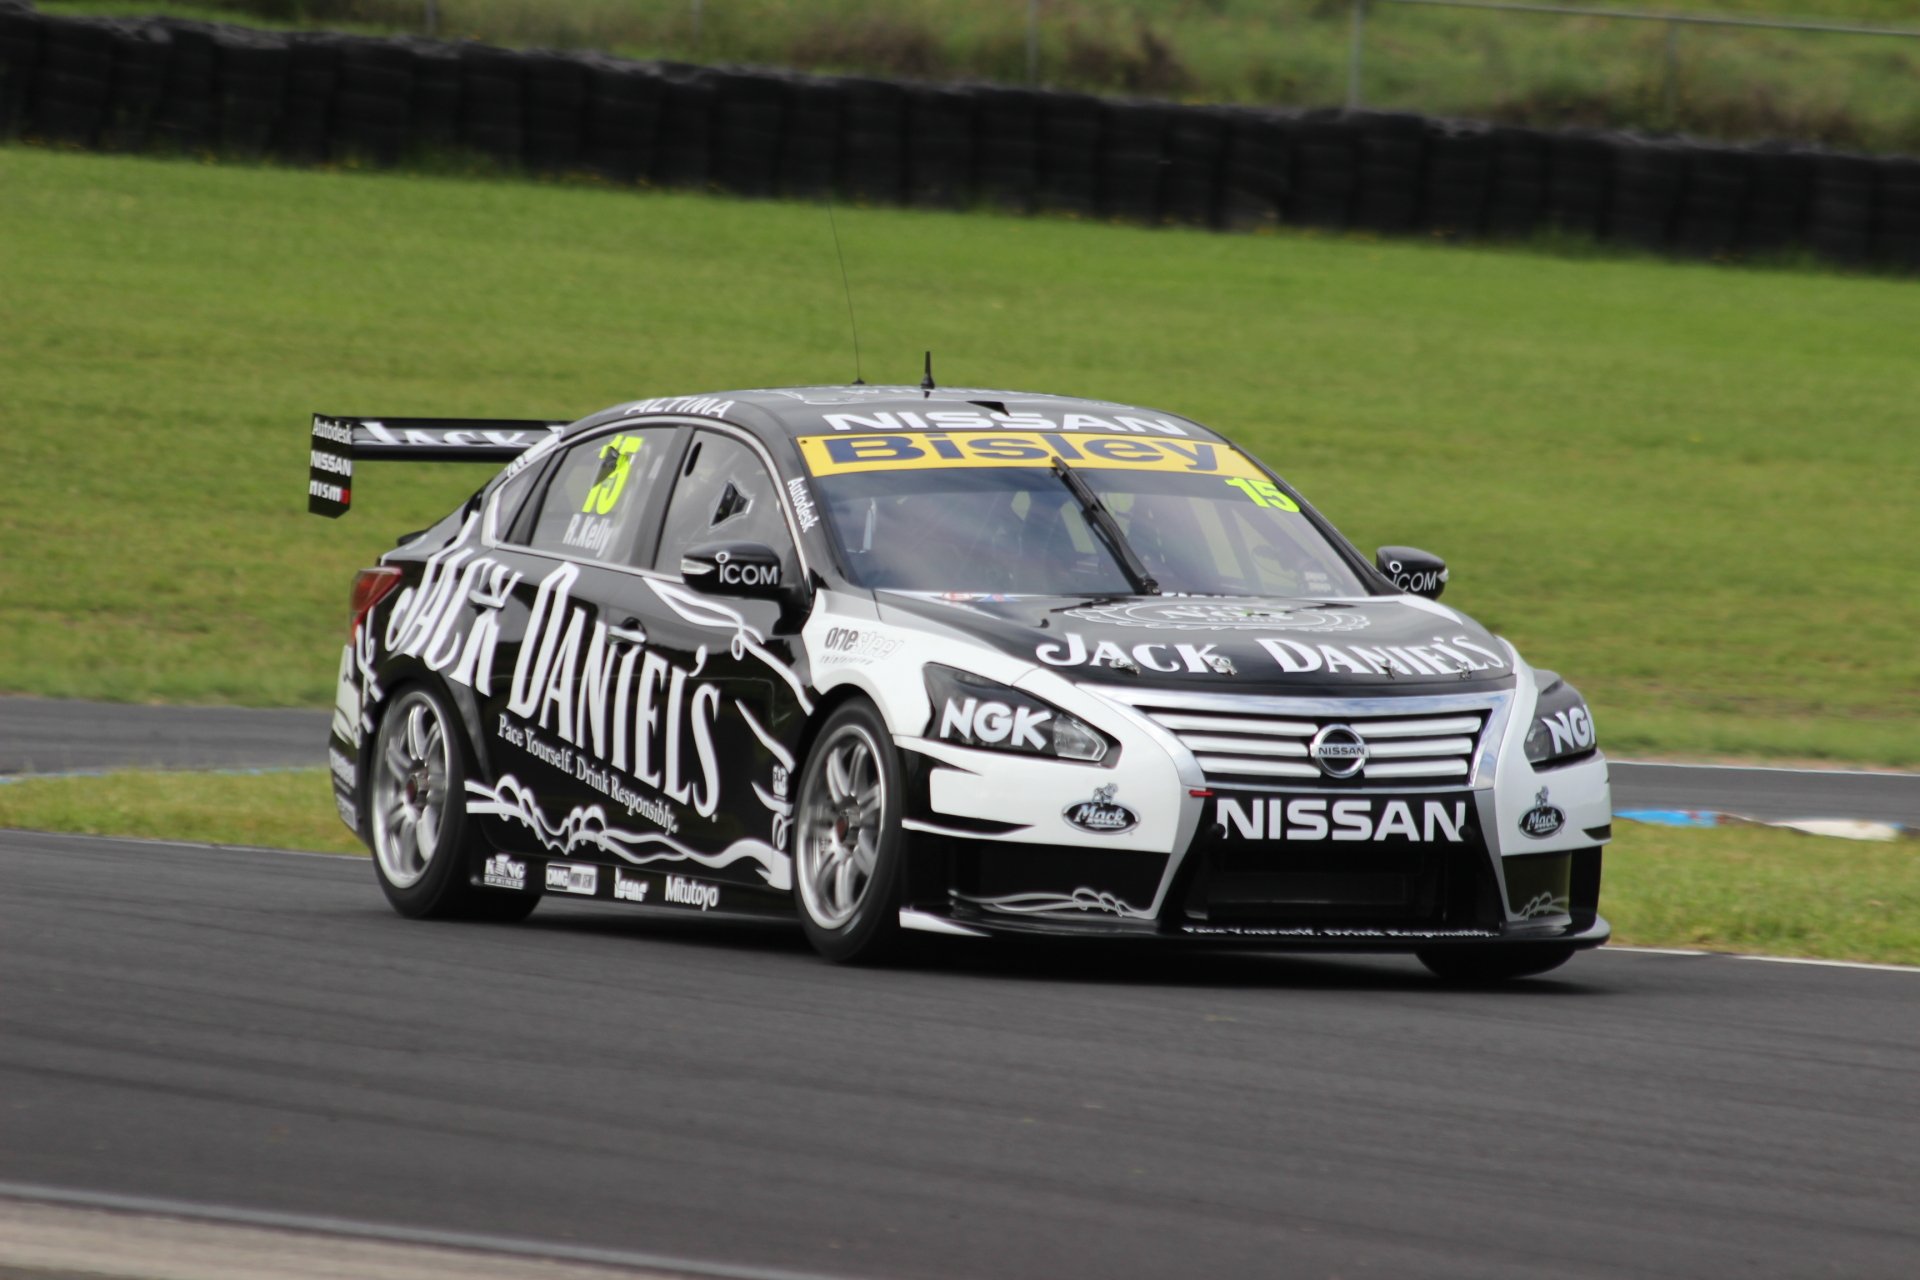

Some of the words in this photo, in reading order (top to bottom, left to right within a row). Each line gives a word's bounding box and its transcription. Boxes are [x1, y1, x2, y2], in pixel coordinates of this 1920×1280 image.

[624, 397, 735, 418] ALTIMA
[821, 411, 1188, 436] NISSAN
[312, 417, 352, 445] Autodesk
[310, 450, 352, 476] NISSAN
[824, 433, 1218, 471] Bisley
[582, 434, 644, 515] 15
[788, 477, 820, 533] Autodesk
[1225, 476, 1300, 513] 15
[384, 511, 524, 698] JACK
[507, 562, 720, 818] DANIEL'S
[1035, 632, 1237, 675] JACK
[939, 698, 1052, 751] NGK
[1318, 746, 1365, 756] NISSAN
[497, 714, 523, 748] Pace
[525, 728, 574, 775] Yourself.
[575, 756, 609, 796] Drink
[610, 775, 676, 836] Responsibly.
[1073, 804, 1127, 828] Mack
[1216, 797, 1466, 842] NISSAN
[1526, 808, 1558, 832] Mack
[664, 875, 719, 911] Mitutoyo
